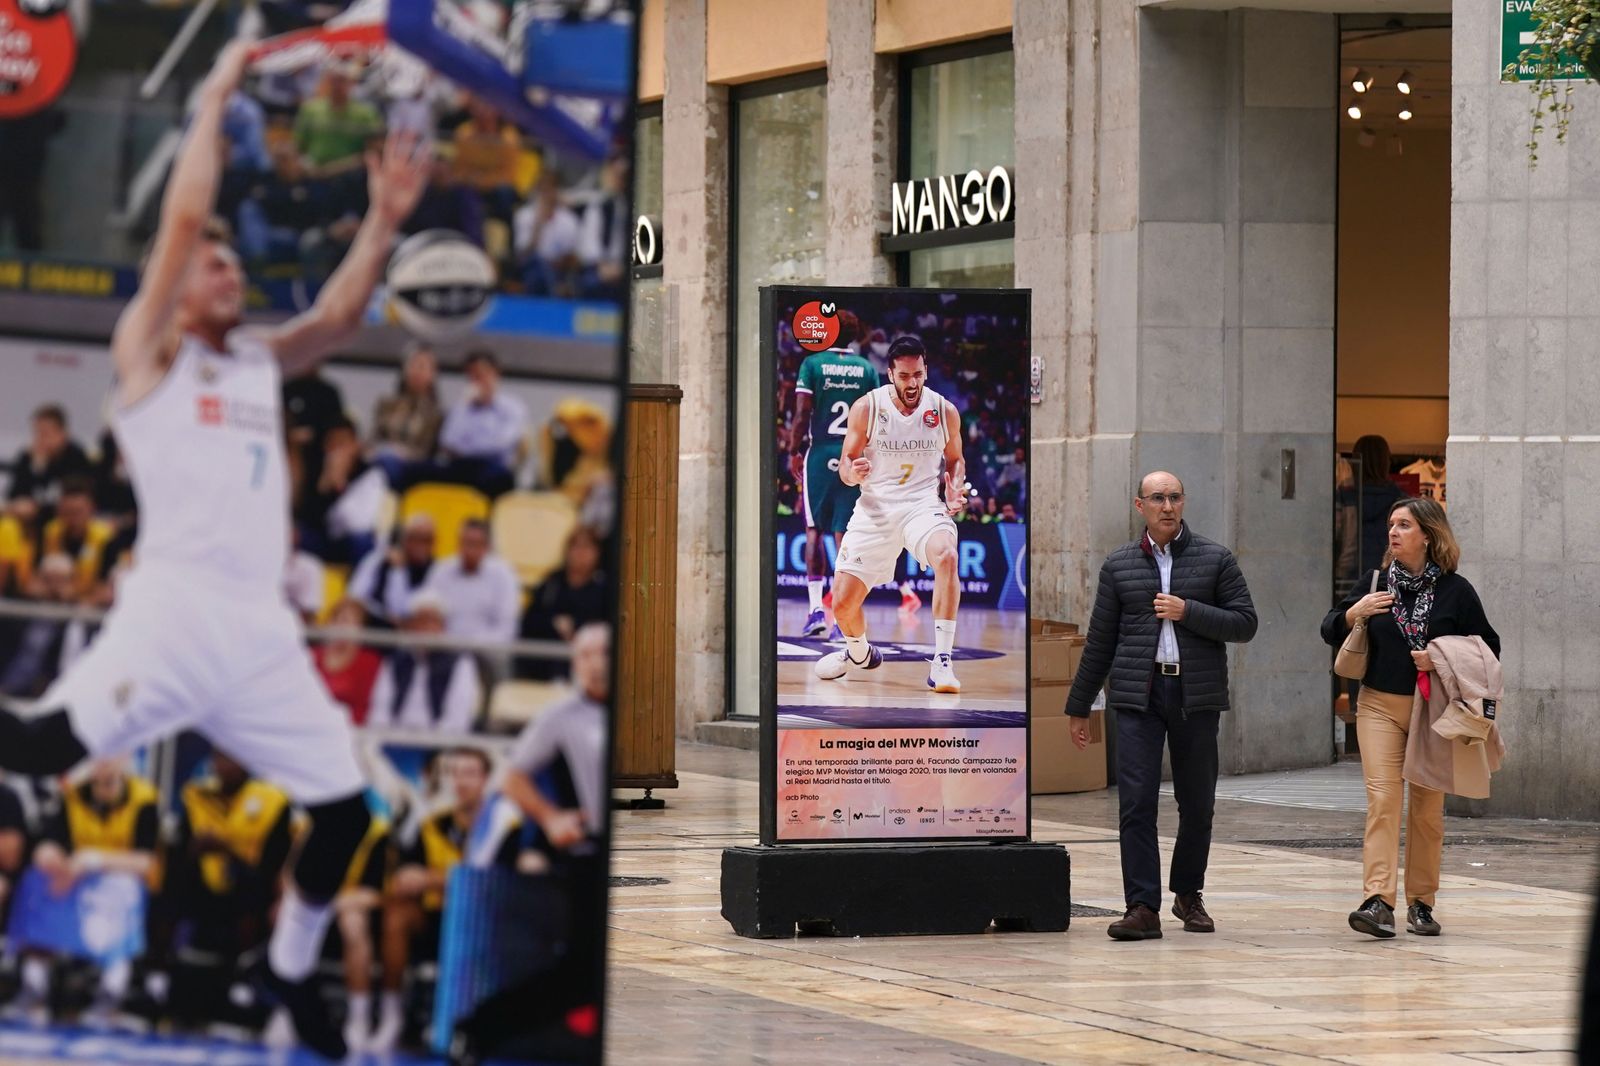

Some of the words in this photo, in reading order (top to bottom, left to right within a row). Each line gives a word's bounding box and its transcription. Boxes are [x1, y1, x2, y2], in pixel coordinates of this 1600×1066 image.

[891, 164, 1011, 236] MANGO
[800, 320, 825, 330] Copa
[812, 329, 828, 339] Rey
[821, 364, 865, 378] THOMPSON
[876, 440, 938, 450] PALLADIUM
[898, 464, 914, 485] 7
[820, 739, 834, 749] La
[837, 737, 875, 750] magia
[878, 738, 897, 749] del
[900, 738, 926, 748] MVP
[928, 736, 980, 748] Movistar
[815, 758, 859, 768] temporada
[861, 758, 893, 766] brillante
[895, 759, 914, 767] para
[928, 757, 960, 765] Facundo
[962, 757, 1003, 766] Campazzo
[1005, 756, 1017, 764] fue
[785, 768, 815, 777] elegido
[834, 767, 866, 775] Movistar
[879, 766, 908, 776] Málaga
[932, 766, 947, 774] tras
[983, 766, 1017, 774] volandas
[785, 777, 794, 785] al
[795, 777, 811, 785] Real
[813, 777, 840, 785] Madrid
[841, 777, 863, 785] hasta
[864, 777, 871, 785] el
